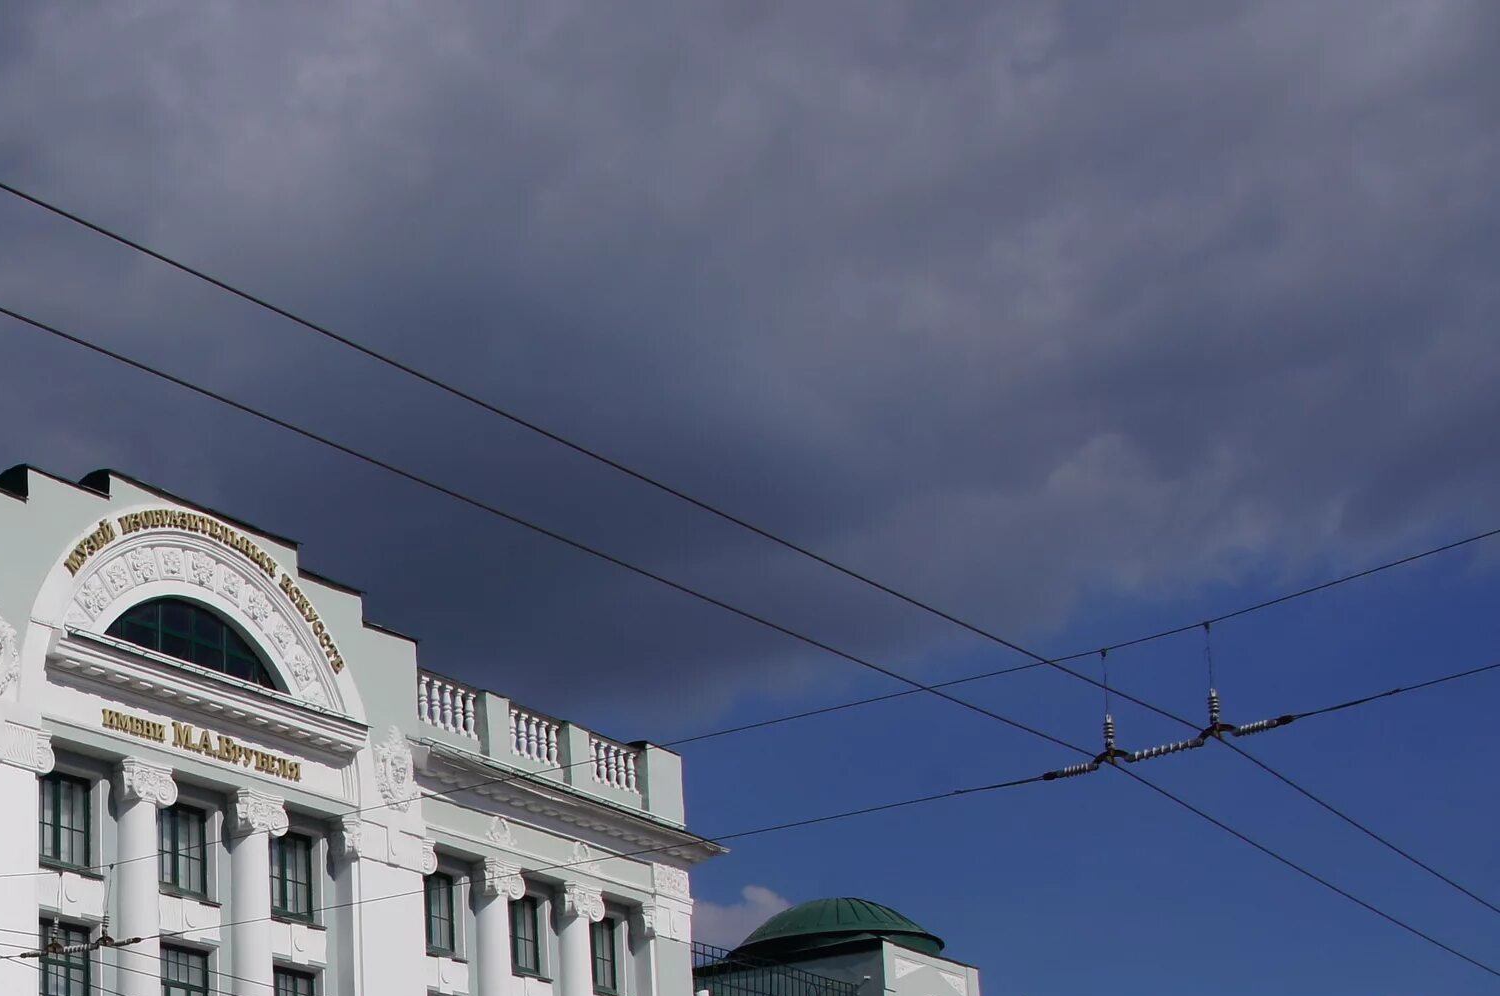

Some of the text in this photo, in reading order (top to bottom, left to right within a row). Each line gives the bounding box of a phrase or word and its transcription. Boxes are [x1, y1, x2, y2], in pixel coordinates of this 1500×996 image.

[64, 508, 345, 675] МУЗЕЙ ИЗОБРАЗИТЕЛЬНЫХ ИСКУССТВ
[101, 708, 166, 743] ИМЕНИ
